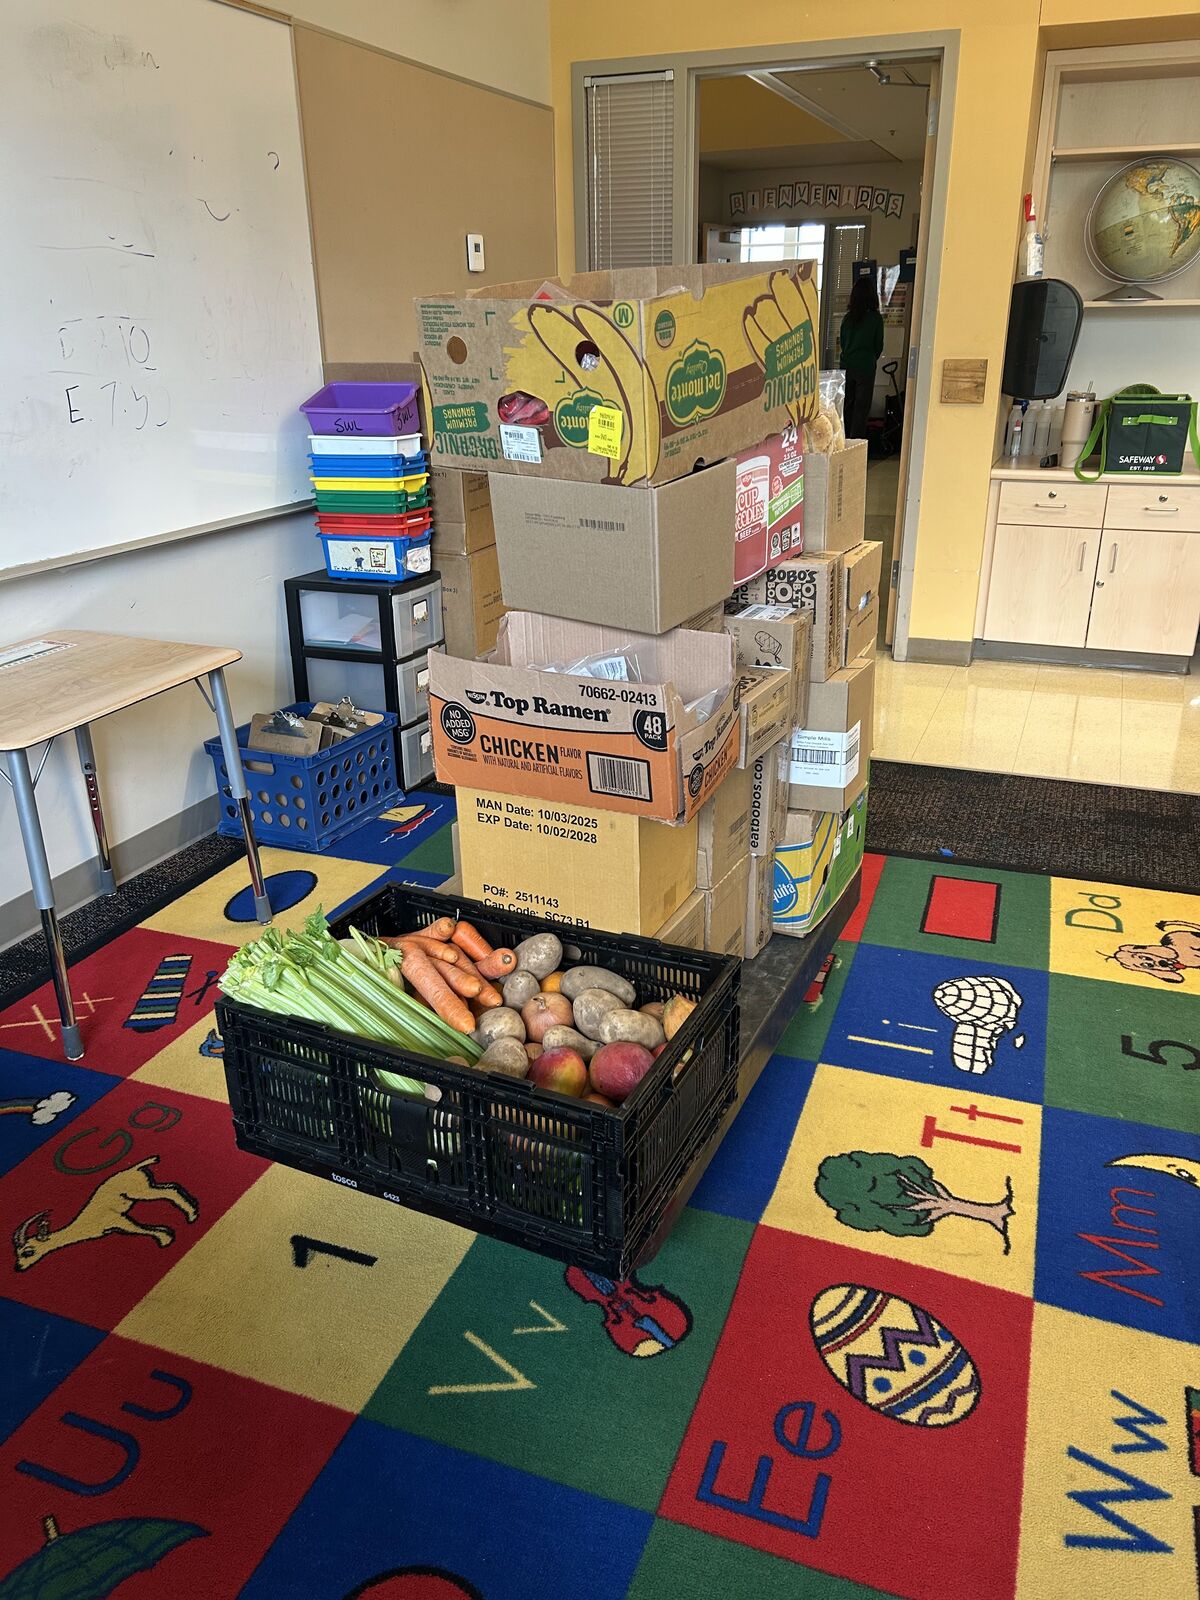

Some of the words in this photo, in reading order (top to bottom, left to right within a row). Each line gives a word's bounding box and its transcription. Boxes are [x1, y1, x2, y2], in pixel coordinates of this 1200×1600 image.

[734, 182, 899, 211] BIENVENIDOS
[776, 328, 804, 357] BANANAS
[776, 344, 804, 372] PREMIUM
[671, 379, 705, 402] Monte
[705, 371, 721, 393] Del
[764, 364, 816, 412] ORGANIC
[334, 417, 363, 433] SWL
[442, 406, 475, 419] BANANAS
[445, 417, 477, 430] PREMIUM
[435, 432, 499, 460] ORGANIC
[781, 427, 799, 449] 24
[1119, 456, 1156, 464] SAFEWAY
[737, 487, 759, 510] CUP
[739, 527, 752, 540] BEEF
[766, 568, 818, 583] BOBO'S
[490, 690, 530, 716] Top
[532, 696, 609, 722] Ramen
[578, 684, 657, 707] 70662-02413
[445, 719, 471, 728] ADDED
[449, 709, 462, 719] NO
[643, 715, 662, 735] 48
[479, 734, 560, 765] CHICKEN
[560, 746, 582, 760] FLAVOR
[644, 733, 662, 741] PACK
[482, 754, 497, 766] WITH
[497, 757, 520, 771] NATURAL
[520, 760, 532, 772] AND
[532, 762, 559, 777] ARTIFICIAL
[559, 766, 583, 780] FLAVORS
[476, 798, 503, 811] MAN
[506, 803, 534, 817] Date:
[538, 809, 598, 829] 10/03/2025
[477, 812, 500, 825] EXP
[504, 817, 533, 832] Date:
[536, 824, 597, 844] 10/02/2028
[483, 884, 509, 898] PO#:
[515, 891, 559, 909] 2511143
[508, 903, 539, 917] Code:
[1064, 892, 1123, 934] Dd
[1121, 1034, 1200, 1071] 5
[53, 1101, 183, 1176] Gg
[920, 1104, 1024, 1154] Tt
[331, 1172, 358, 1188] tosca
[383, 1191, 401, 1203] 6423
[290, 1234, 379, 1269] 1
[1076, 1186, 1164, 1308] Mm
[428, 1299, 569, 1396] Vv
[15, 1368, 193, 1496] Uu
[695, 1400, 843, 1540] Ee
[1063, 1389, 1175, 1555] Ww
